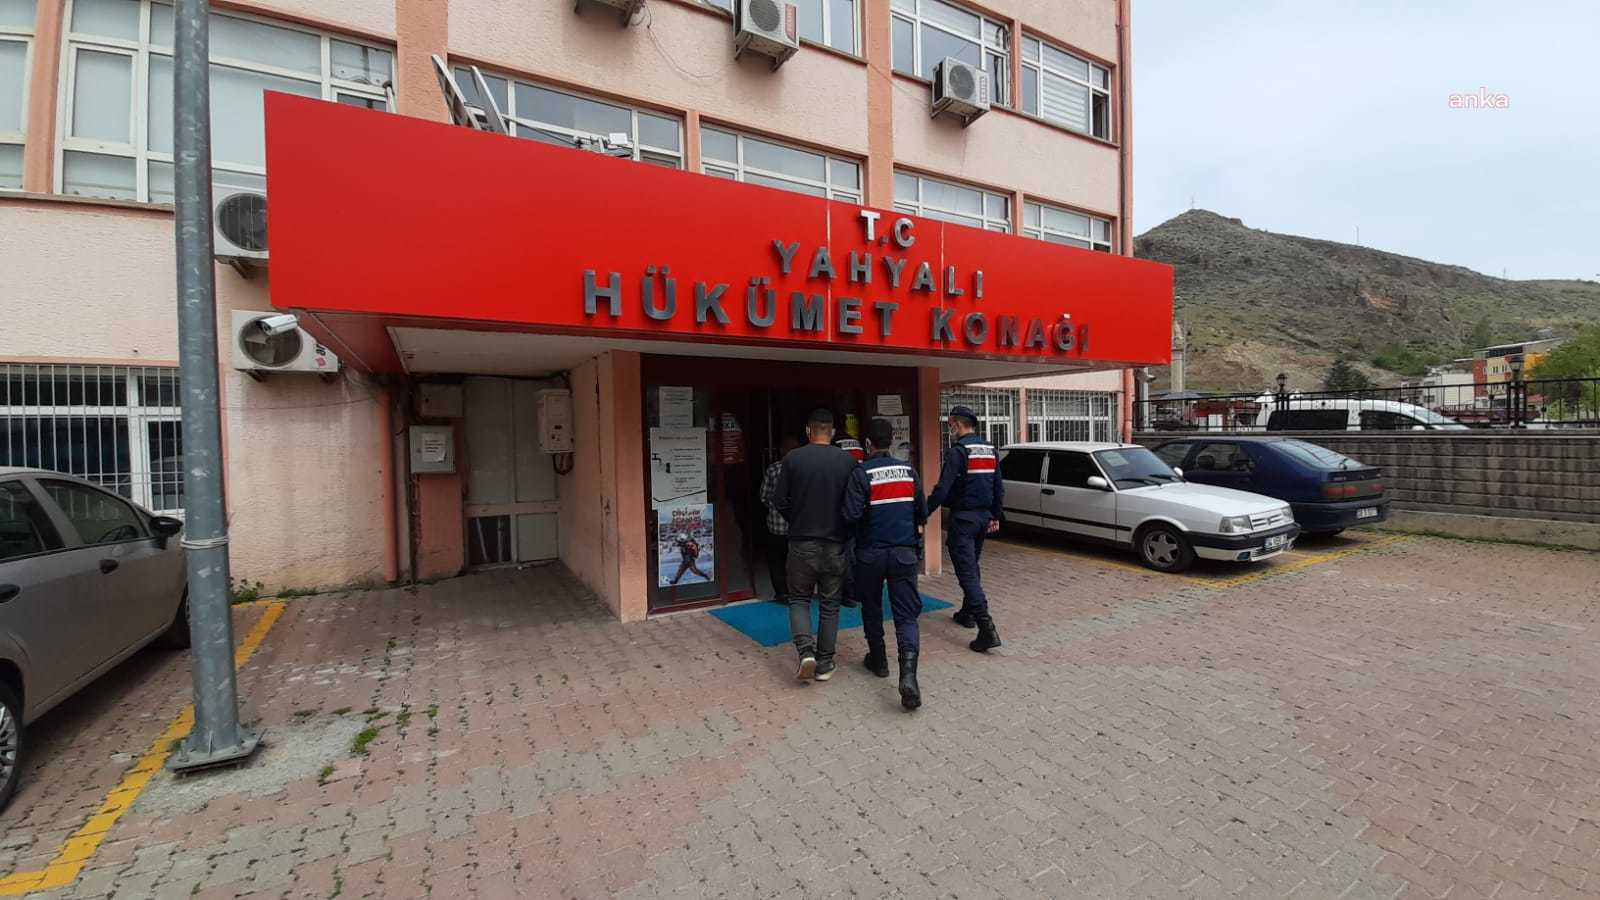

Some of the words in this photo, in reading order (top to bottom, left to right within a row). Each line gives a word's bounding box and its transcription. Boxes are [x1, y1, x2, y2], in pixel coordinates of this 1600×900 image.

[773, 239, 983, 298] YAHYALI
[584, 266, 899, 339] HÜKÜMET
[931, 308, 1089, 353] KONAĞI
